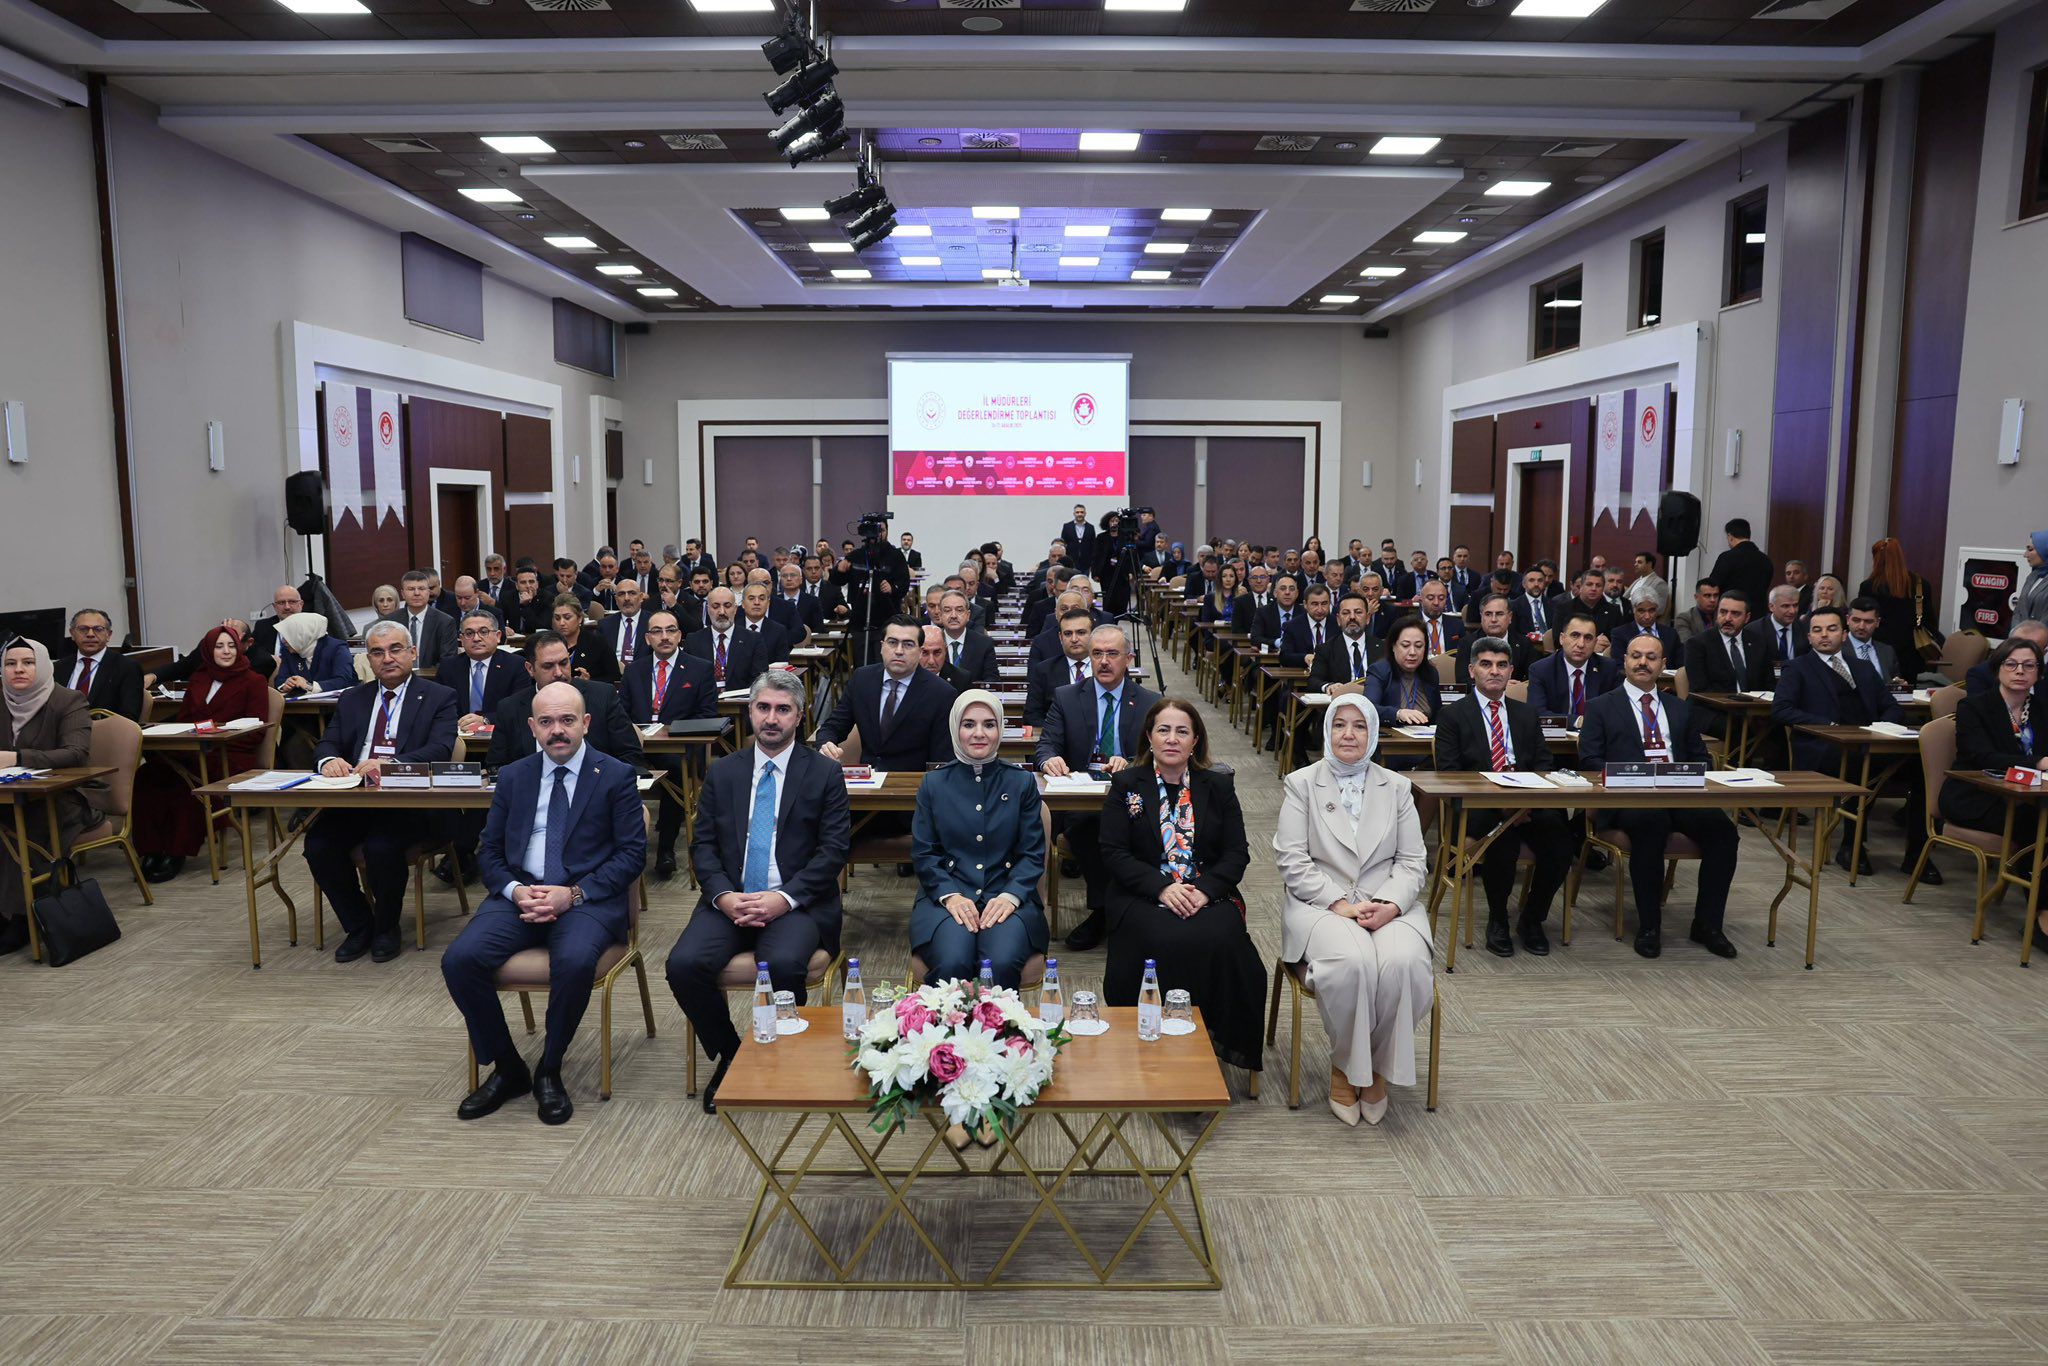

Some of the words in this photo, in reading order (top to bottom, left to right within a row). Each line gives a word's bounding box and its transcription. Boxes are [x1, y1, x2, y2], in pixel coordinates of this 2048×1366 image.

[991, 394, 1031, 406] MÜDÜRLERİ
[958, 408, 1014, 420] DEĞERLENDİRME
[1016, 410, 1057, 420] TOPLANTISI
[1975, 575, 2005, 587] YANGIN
[1977, 611, 1996, 621] FIRE
